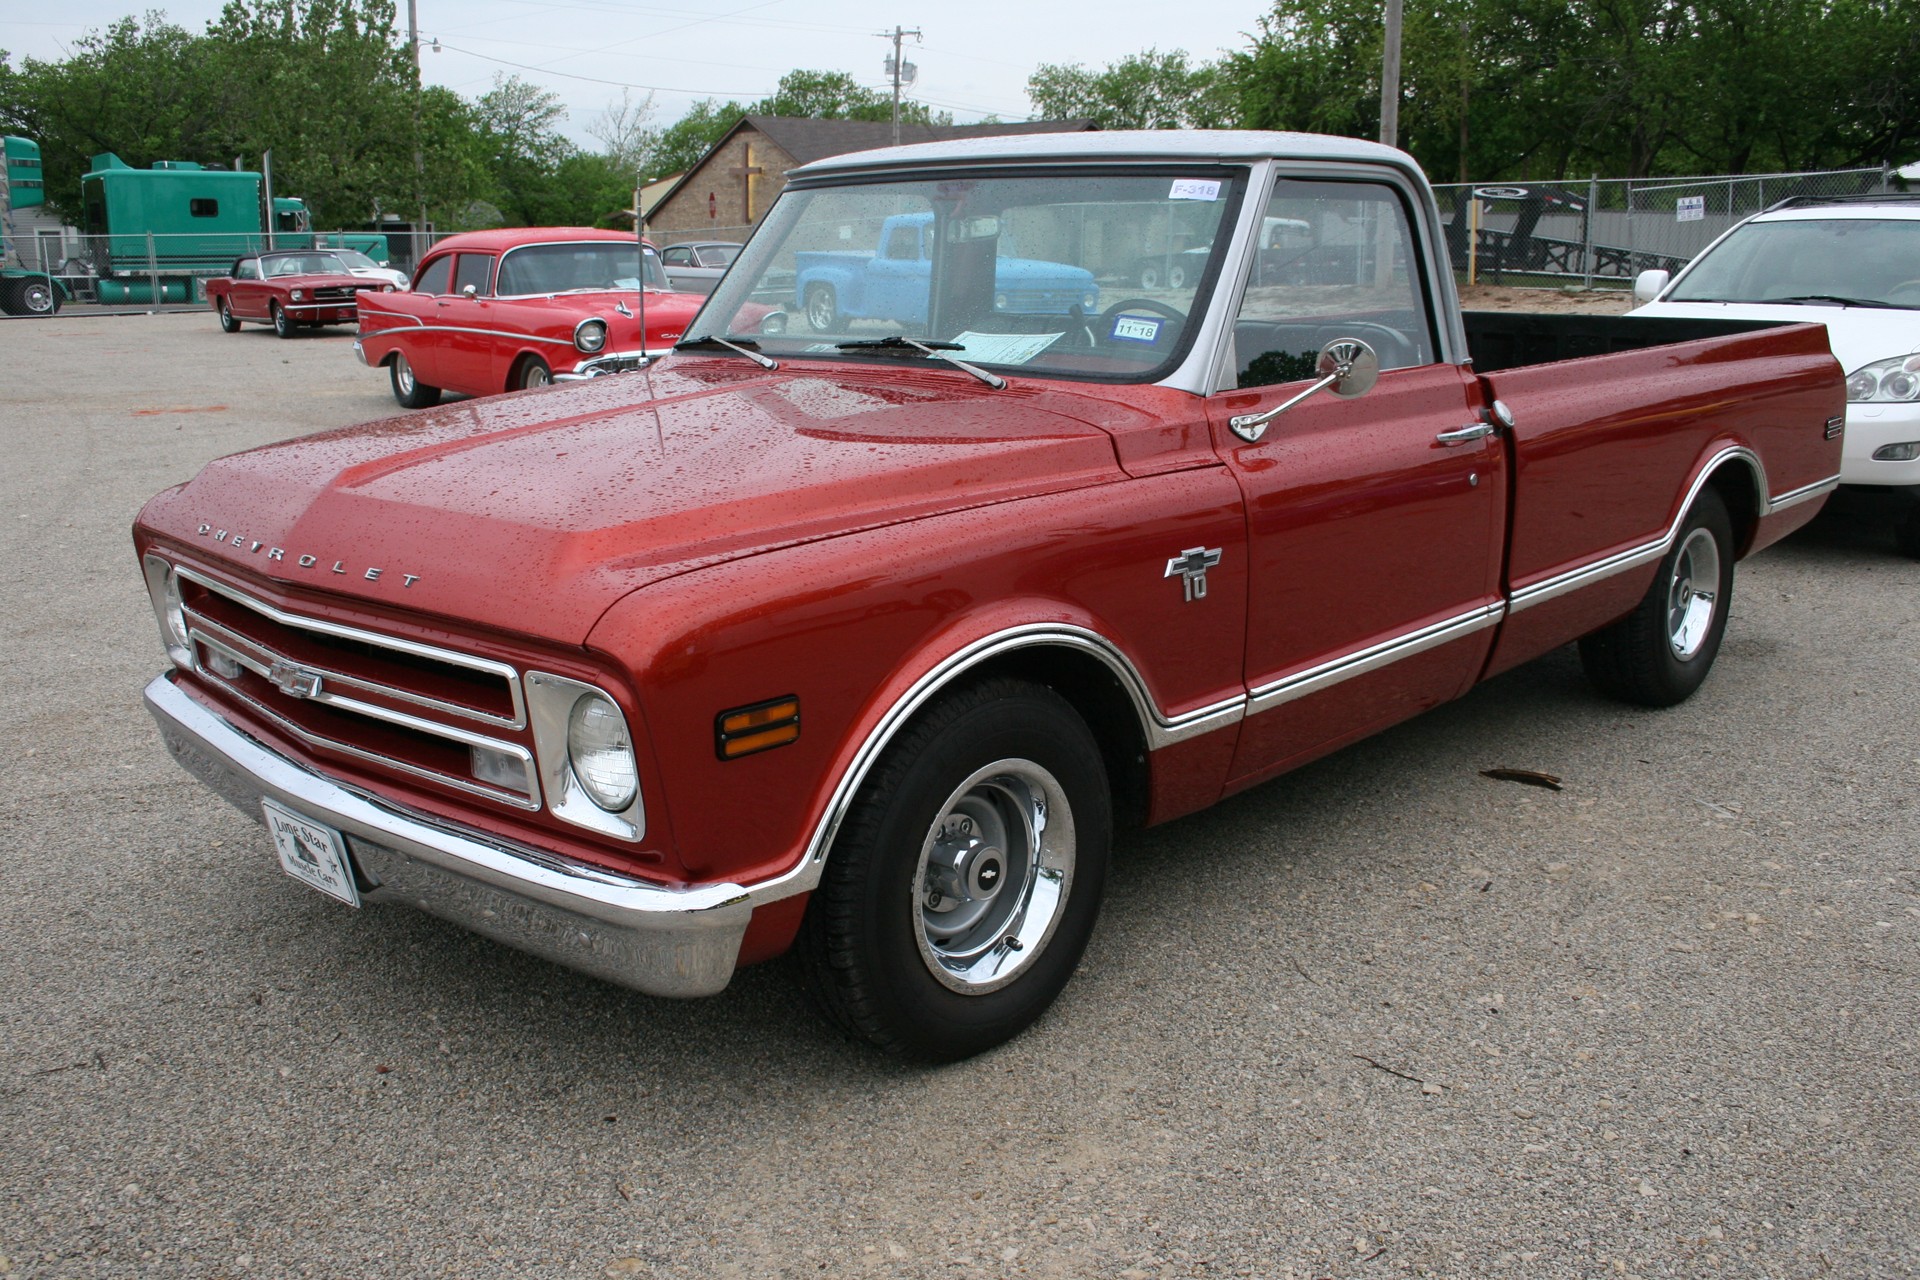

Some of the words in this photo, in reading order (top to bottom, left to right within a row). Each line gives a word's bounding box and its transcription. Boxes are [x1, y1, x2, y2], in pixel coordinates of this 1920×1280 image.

[1173, 184, 1216, 196] F-318
[198, 523, 421, 588] CHEVROLET
[1183, 573, 1207, 602] 10
[273, 816, 299, 836] Lone
[300, 826, 328, 853] Star
[287, 853, 317, 877] Muscle
[317, 868, 339, 887] Cars
